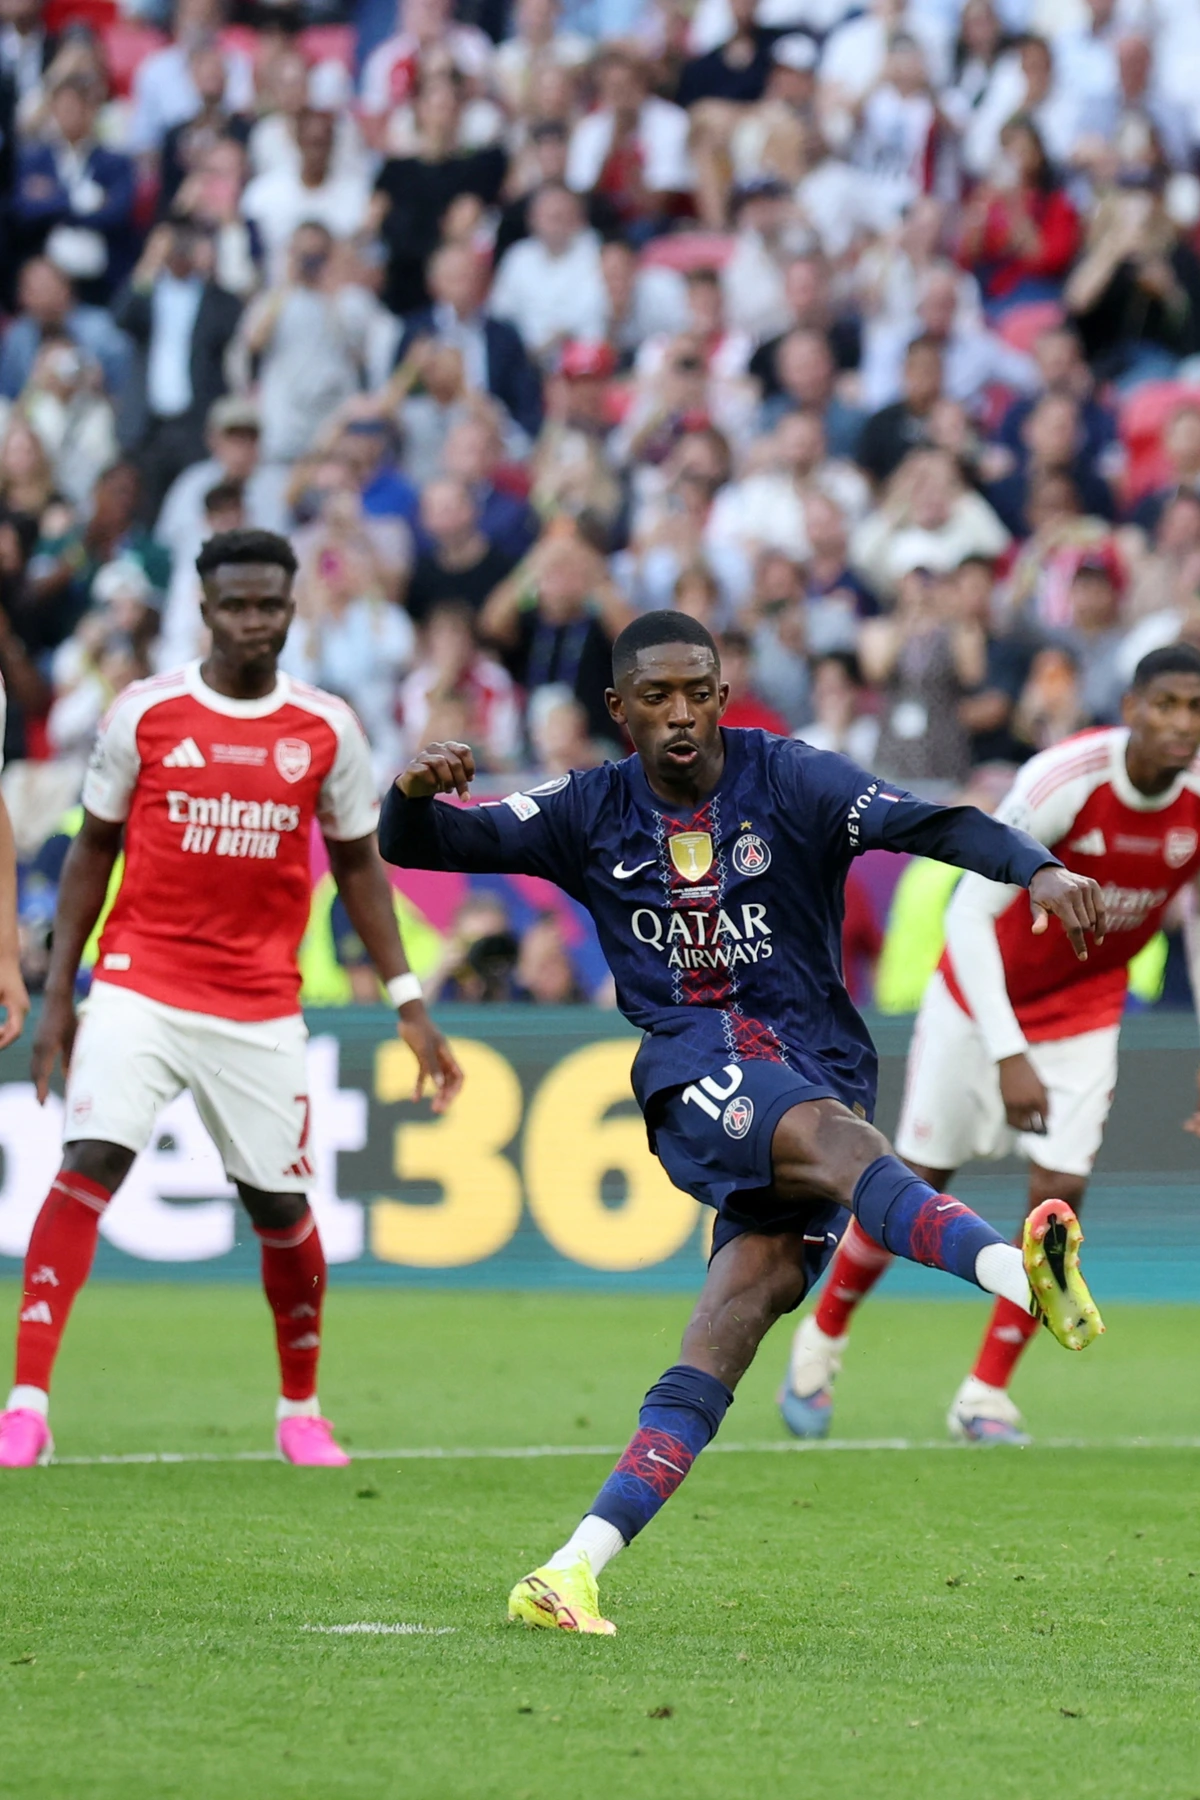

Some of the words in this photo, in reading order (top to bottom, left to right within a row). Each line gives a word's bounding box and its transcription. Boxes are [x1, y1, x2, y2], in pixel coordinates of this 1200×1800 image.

[166, 790, 300, 832] Emirates
[847, 781, 880, 847] BEYON
[181, 824, 216, 854] FLY
[216, 828, 280, 859] BETTER
[738, 836, 761, 848] PARIS
[631, 903, 773, 951] QATAR
[667, 937, 773, 969] AIRWAYS
[293, 1094, 311, 1149] 7
